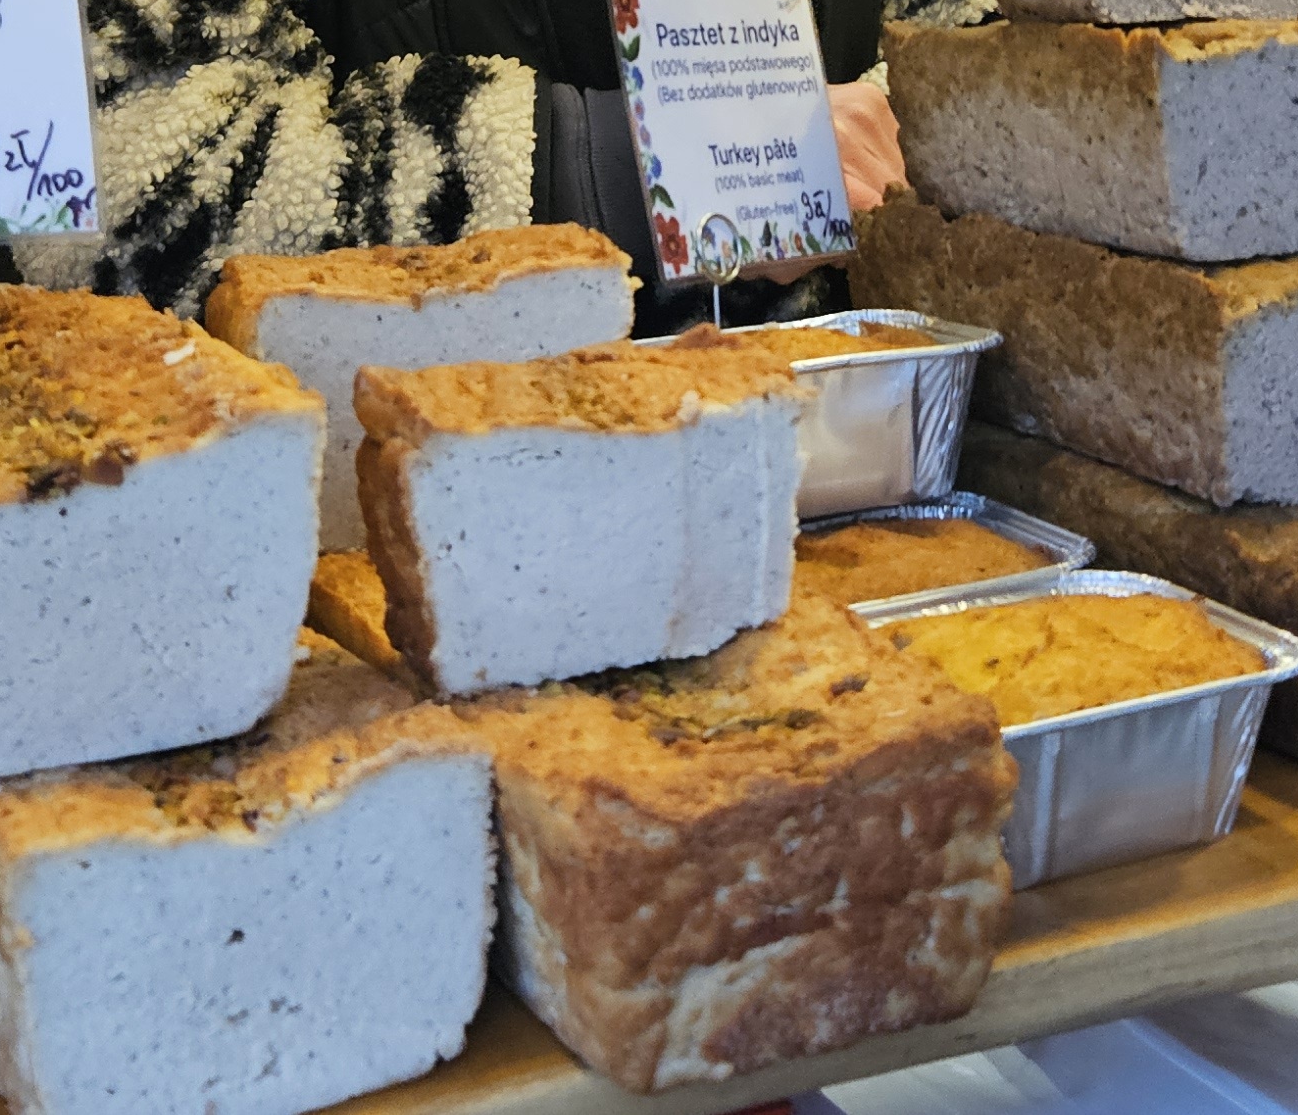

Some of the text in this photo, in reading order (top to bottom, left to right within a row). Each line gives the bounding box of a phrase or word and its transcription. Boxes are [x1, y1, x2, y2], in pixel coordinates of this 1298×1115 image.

[656, 19, 800, 47] Pasztet z indyka
[651, 52, 815, 80] (100% mięsa podstawowego)
[657, 75, 819, 106] (Bez dodatków glutenowych)
[708, 136, 798, 166] Turkey pâté
[714, 172, 747, 194] (100%
[747, 171, 775, 188] basic
